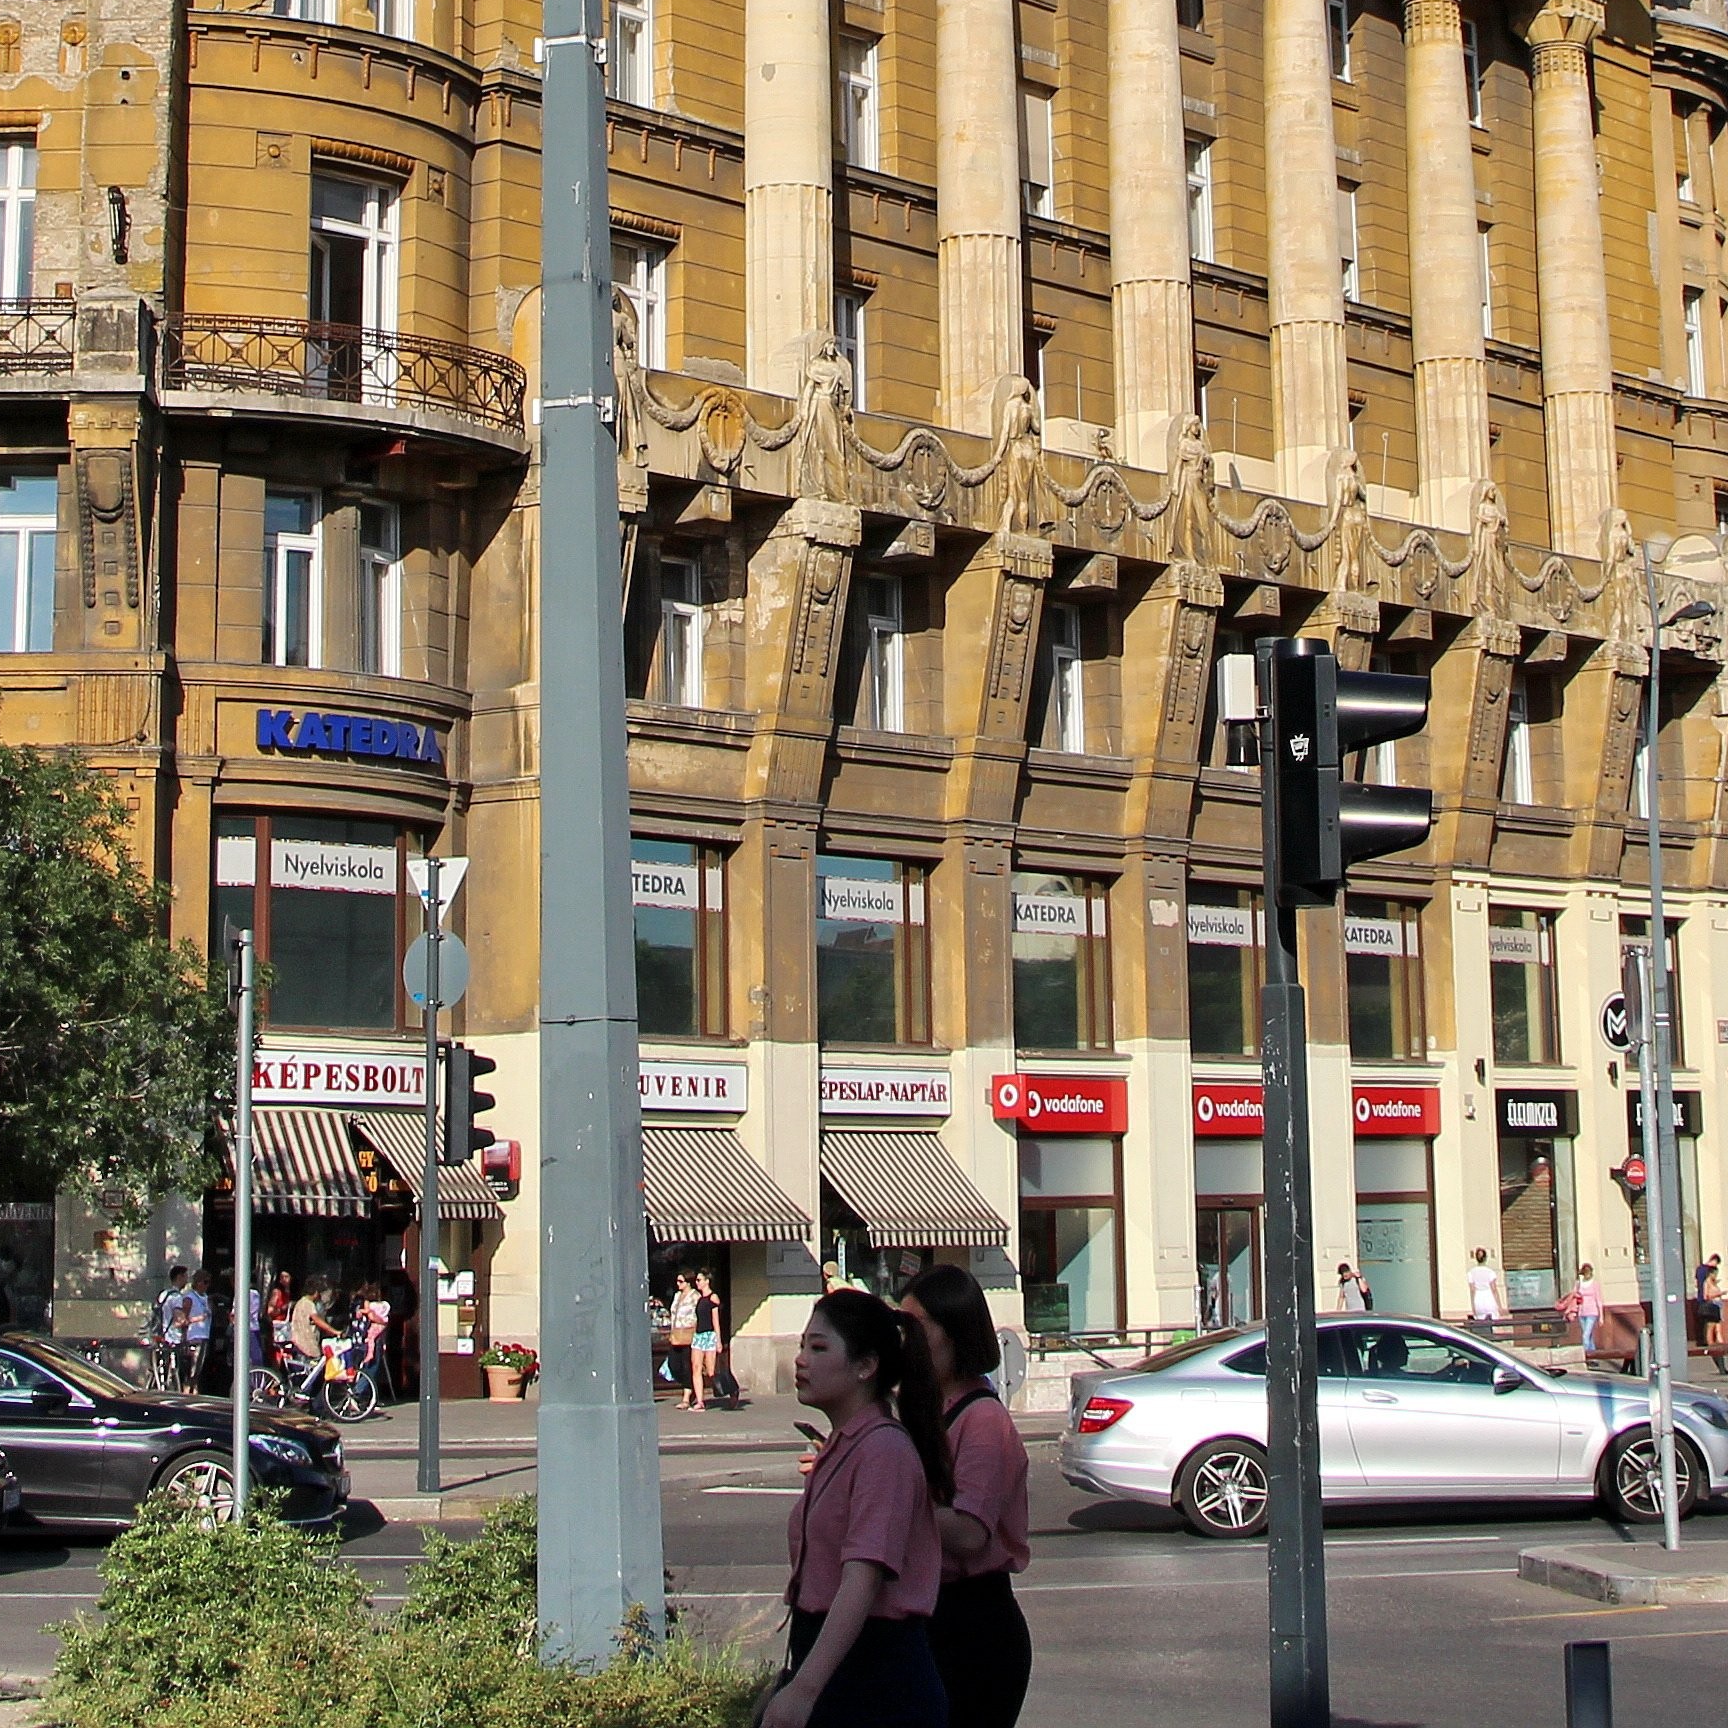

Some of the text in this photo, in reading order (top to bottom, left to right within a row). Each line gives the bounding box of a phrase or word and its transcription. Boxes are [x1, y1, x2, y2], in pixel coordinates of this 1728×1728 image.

[256, 708, 442, 764] KATEDRA
[284, 852, 385, 881] Nyelviskola
[821, 887, 895, 914] Nyelviskola
[1014, 902, 1077, 925] KATEDRA
[1489, 936, 1533, 956] yelviskola
[251, 1054, 425, 1095] KÉPESBOLT
[819, 1076, 948, 1105] ÉPESLAP-NAPTÁR
[1044, 1096, 1105, 1114] vodafone
[1215, 1101, 1264, 1119] vodafon
[1372, 1101, 1422, 1119] vodafone
